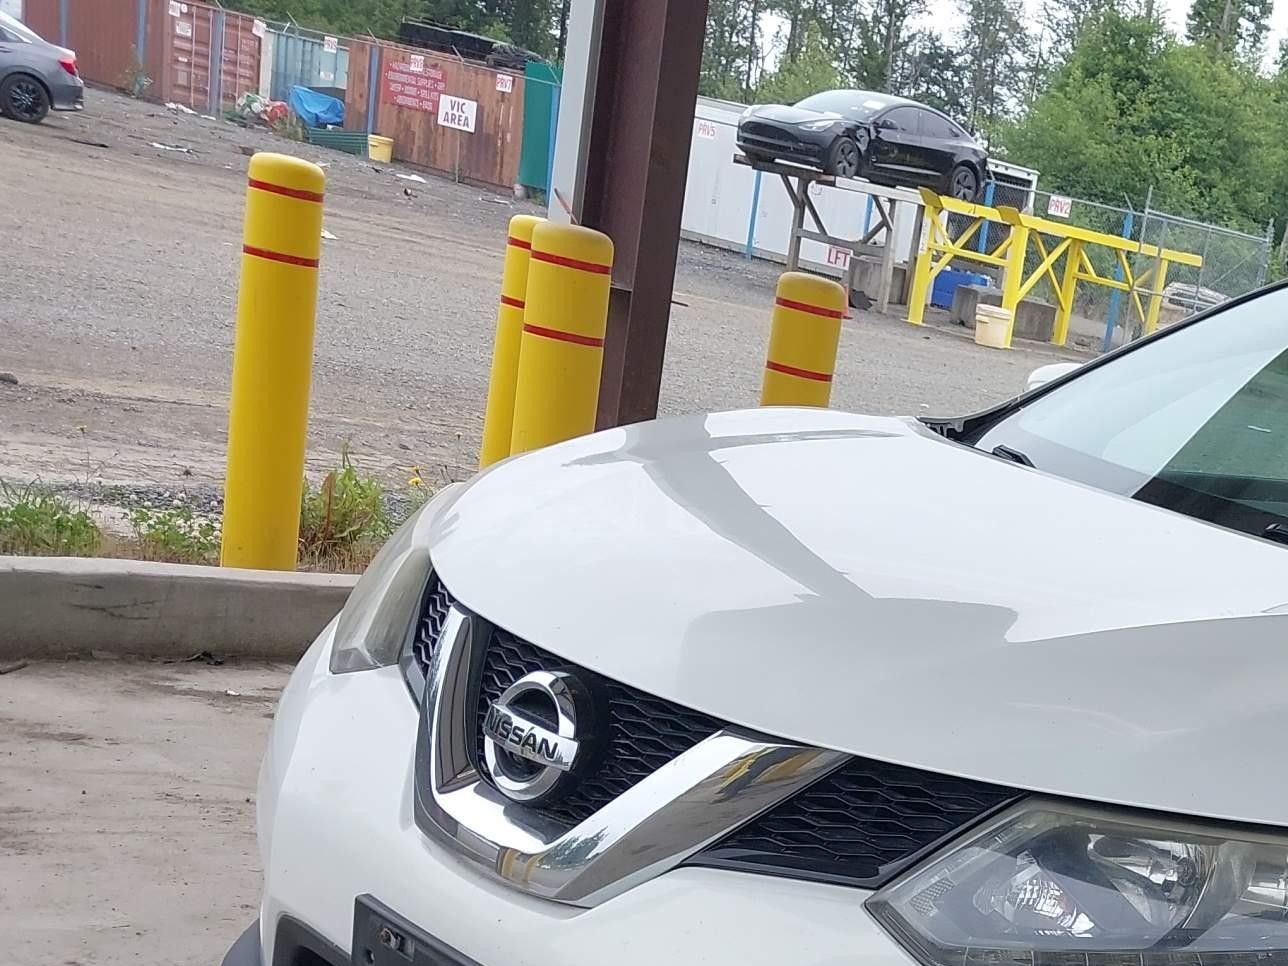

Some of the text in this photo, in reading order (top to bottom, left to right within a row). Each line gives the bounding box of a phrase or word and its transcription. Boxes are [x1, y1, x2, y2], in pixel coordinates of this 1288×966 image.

[496, 77, 512, 89] PRV7
[450, 99, 466, 114] VIC
[442, 112, 470, 129] AREA
[699, 121, 716, 137] PRV5
[1049, 198, 1071, 215] PRV2
[827, 247, 851, 267] LFT
[486, 706, 558, 760] NISSAN
